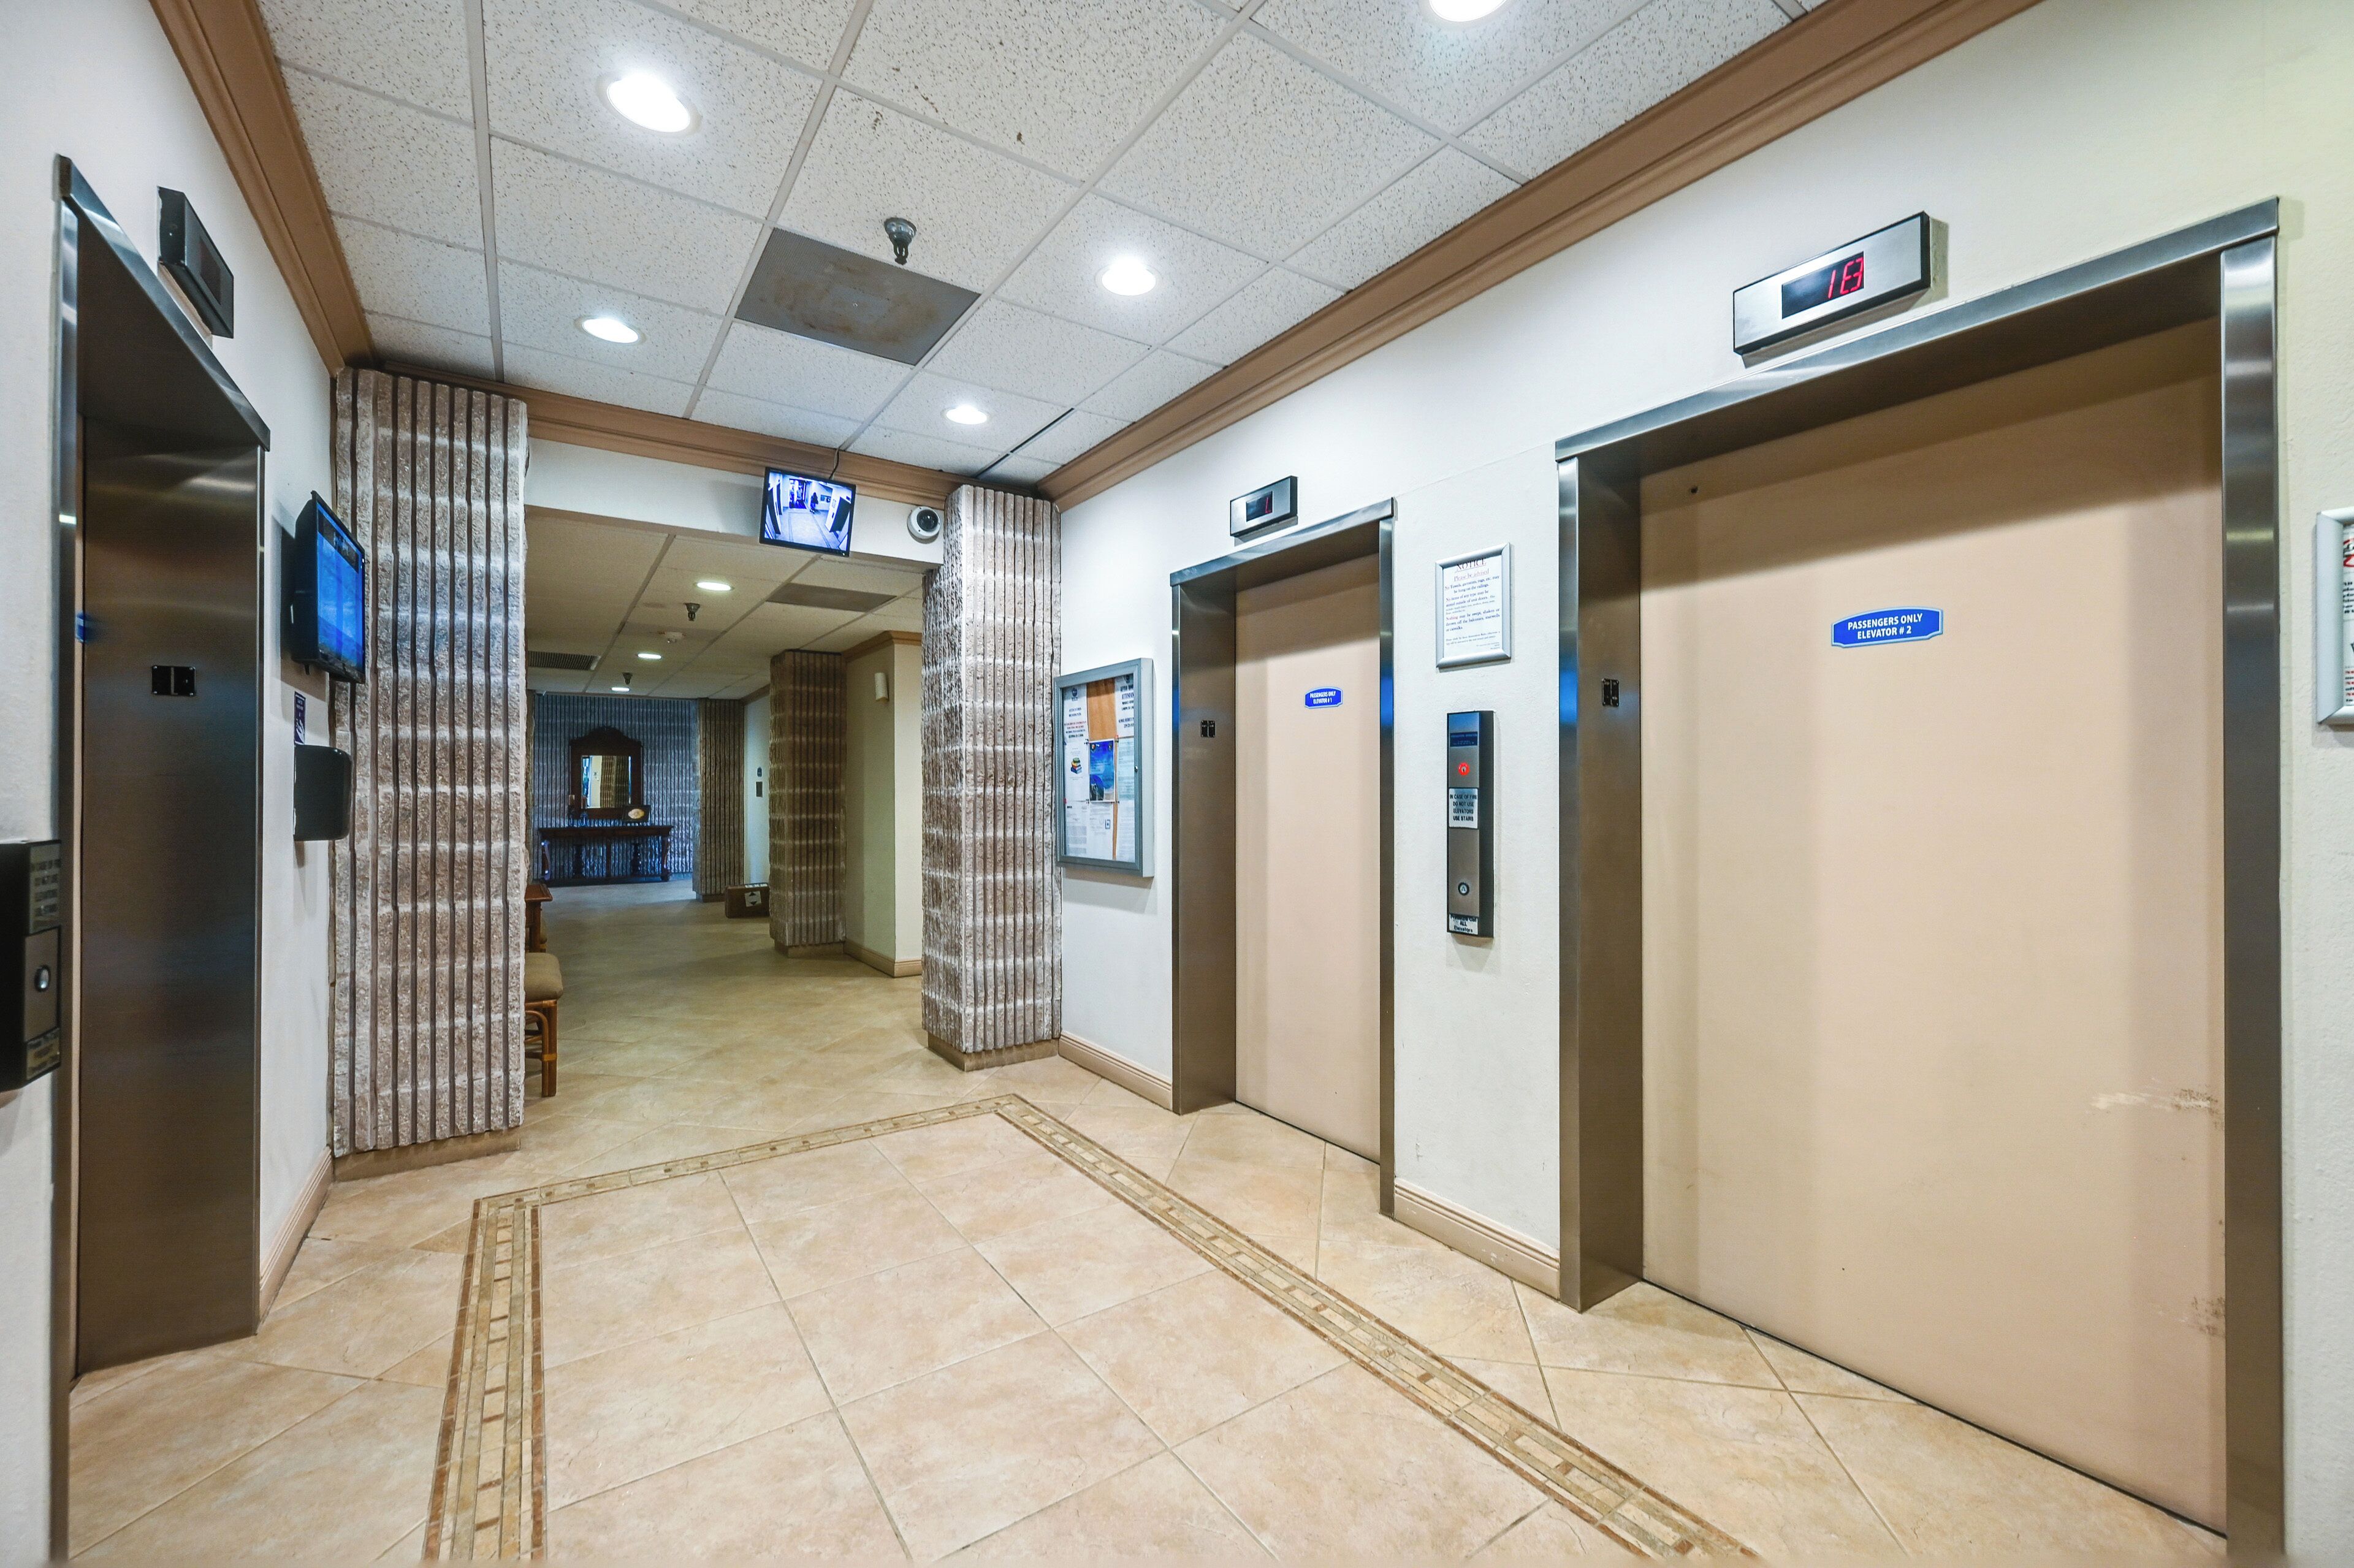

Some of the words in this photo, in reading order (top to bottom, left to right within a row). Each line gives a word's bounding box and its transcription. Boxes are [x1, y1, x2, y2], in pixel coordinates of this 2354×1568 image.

[1828, 257, 1864, 299] 18
[1457, 557, 1487, 570] NOTICE
[1848, 616, 1899, 630] PASSENGERS
[1901, 613, 1922, 623] ONLY
[1857, 627, 1897, 639] ELEVATOR
[1899, 626, 1905, 634] #
[1906, 625, 1911, 634] 2
